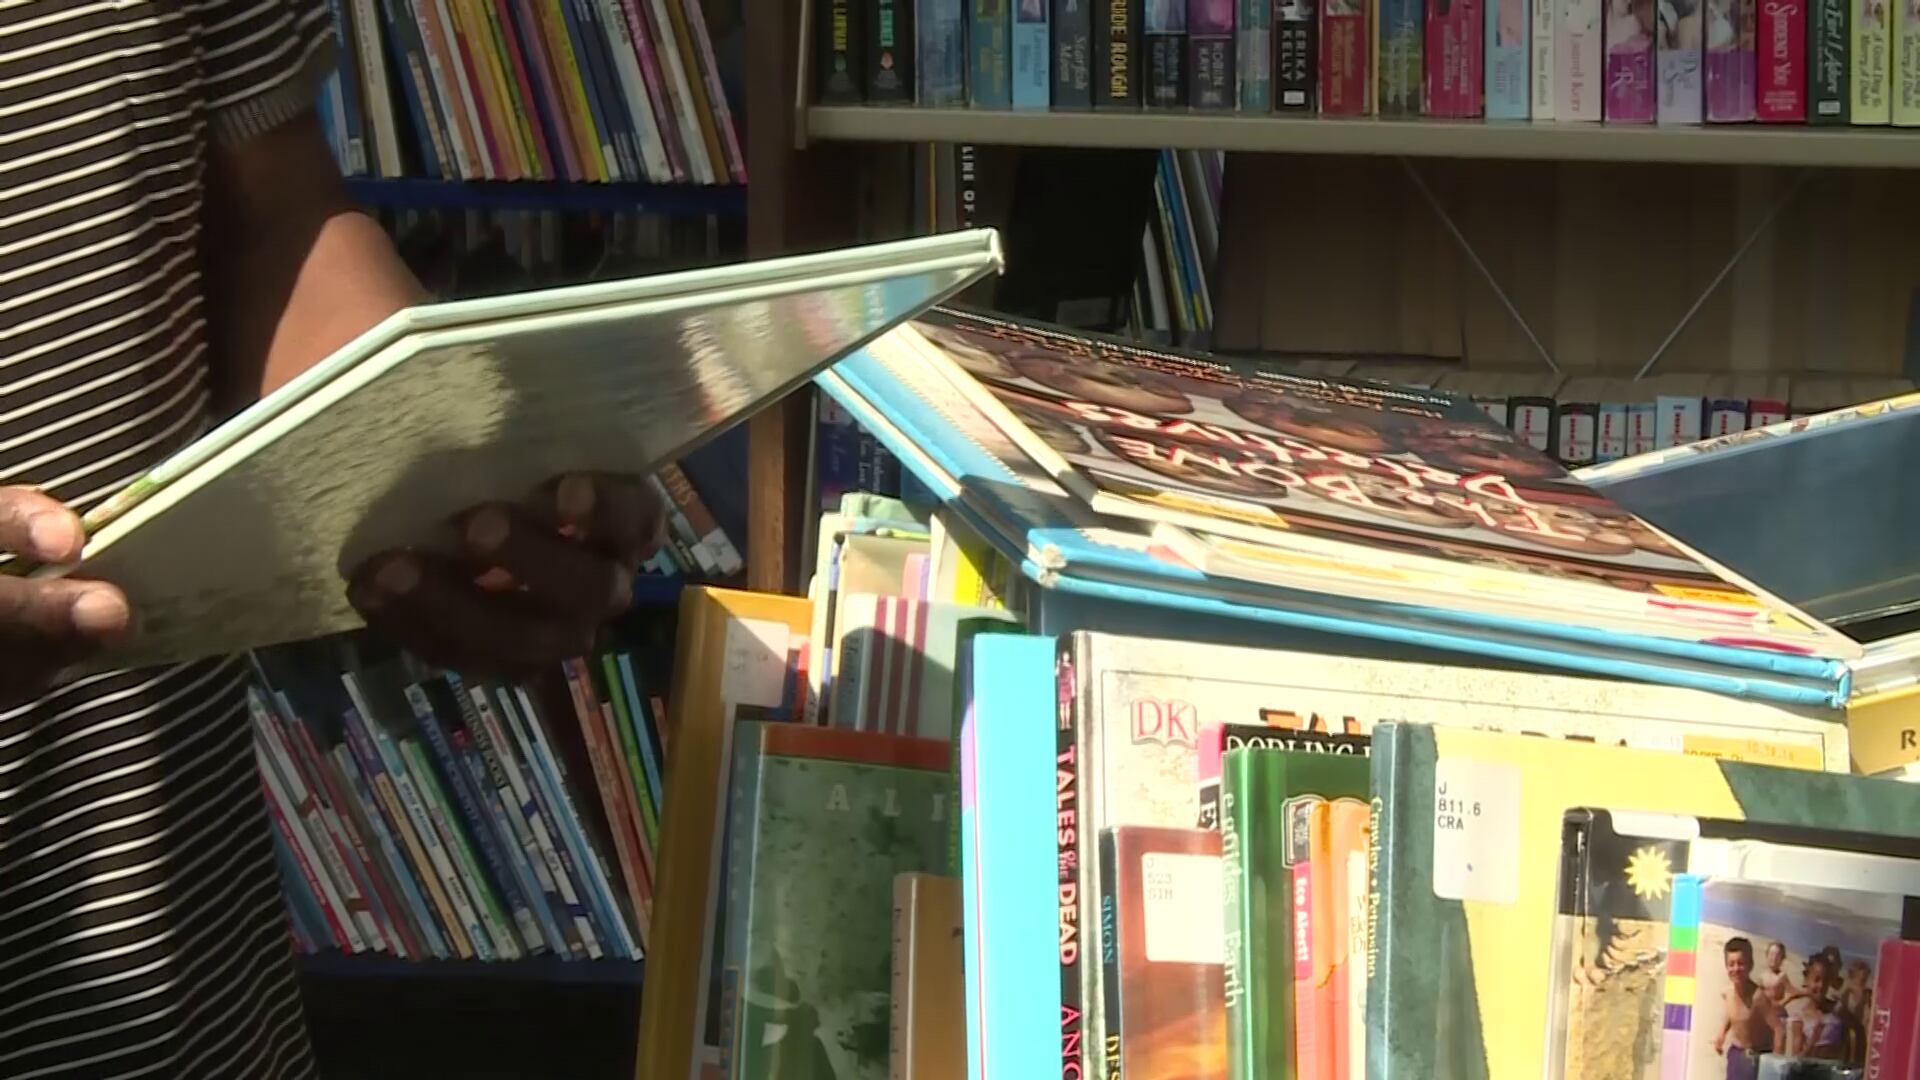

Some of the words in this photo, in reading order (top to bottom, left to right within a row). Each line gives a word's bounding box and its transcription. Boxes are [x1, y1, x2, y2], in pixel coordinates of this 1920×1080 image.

[1110, 41, 1128, 98] ROUGH
[1197, 46, 1210, 81] KAYE
[1212, 41, 1225, 87] ROBIN
[1281, 29, 1293, 81] KELLY
[1295, 29, 1307, 81] ERIKA
[961, 145, 976, 182] LINE
[961, 190, 976, 214] OF
[1110, 434, 1380, 510] BONE
[1136, 696, 1192, 741] DK
[1055, 744, 1077, 854] TALES
[1437, 781, 1448, 797] J
[1437, 797, 1482, 817] 811.6
[1367, 796, 1384, 874] Crawley
[1437, 815, 1466, 832] CRA
[1296, 876, 1308, 906] Eco
[1057, 882, 1078, 966] DEAD
[1103, 895, 1114, 965] SIMON
[1365, 892, 1381, 979] Petrosino
[1221, 930, 1244, 1008] Earth
[1869, 1007, 1892, 1080] FRAD
